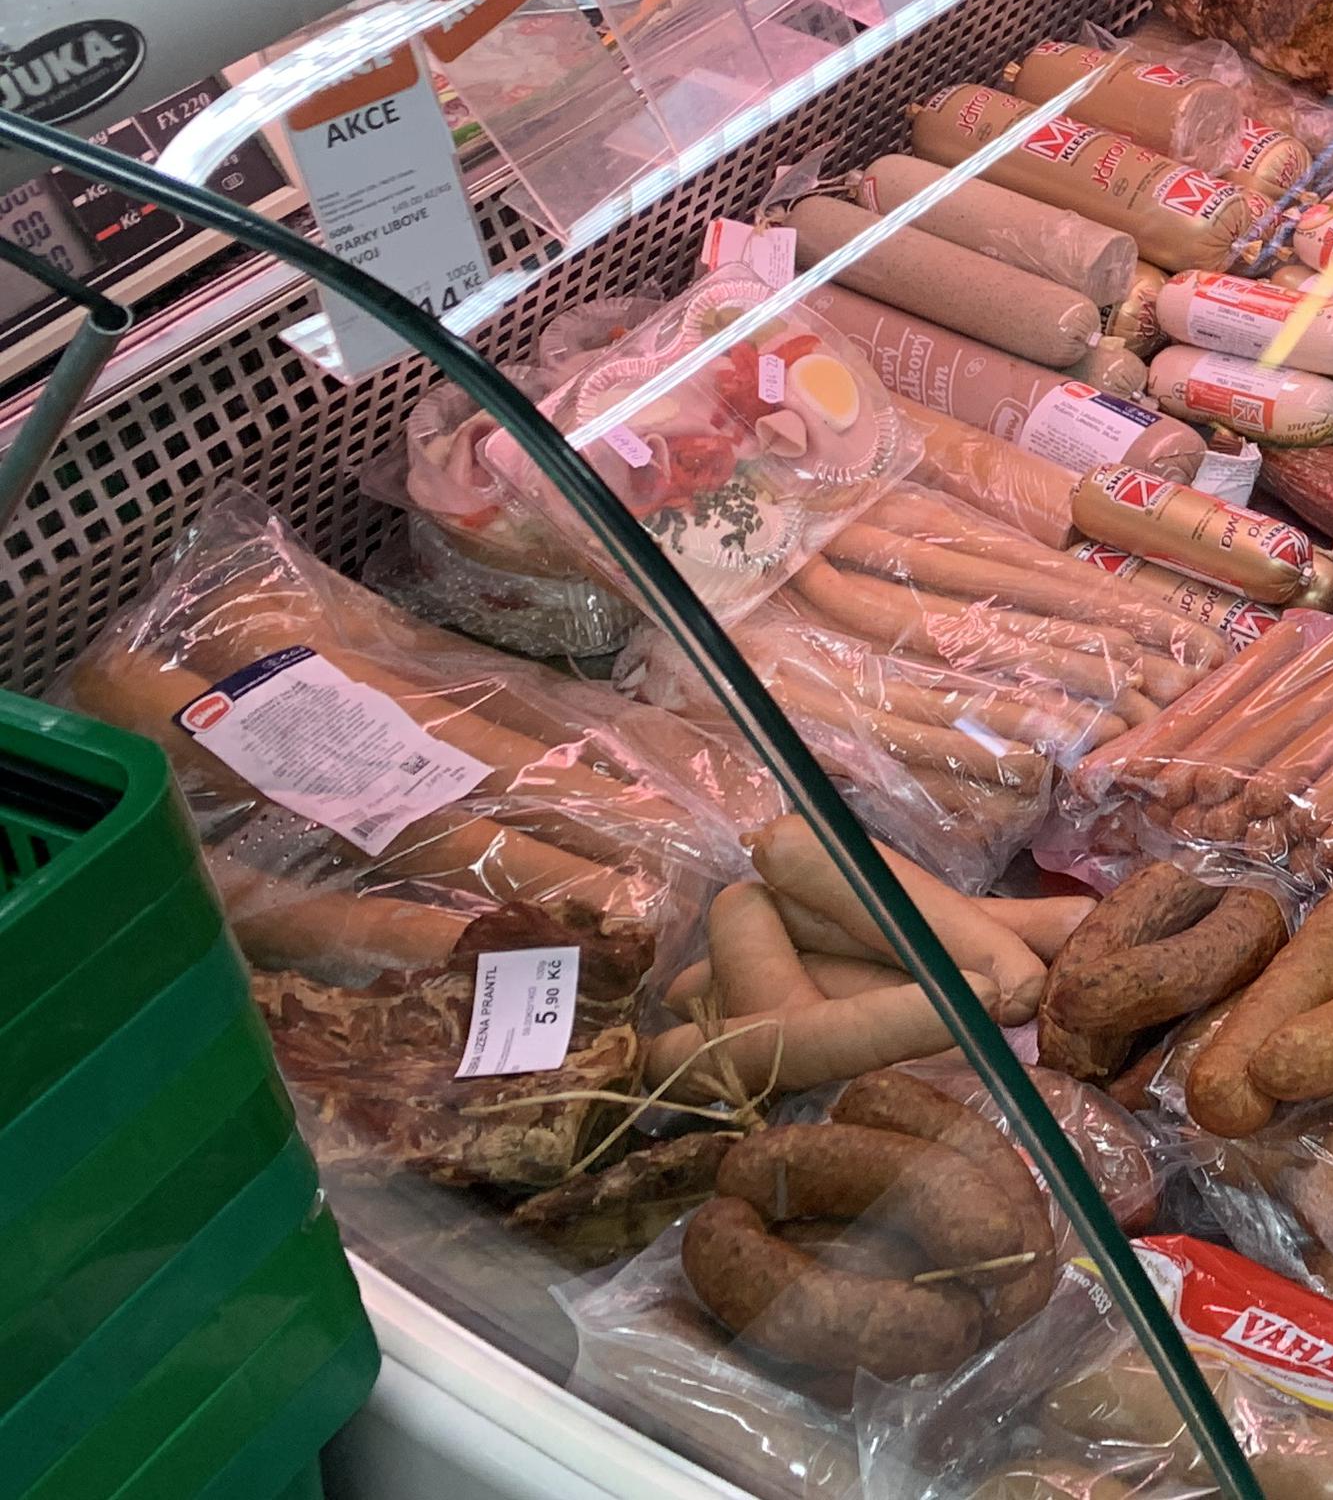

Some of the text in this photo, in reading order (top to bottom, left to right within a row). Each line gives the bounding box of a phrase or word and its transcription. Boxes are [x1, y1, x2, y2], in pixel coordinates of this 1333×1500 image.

[156, 91, 211, 131] FX 220
[326, 99, 402, 149] AKCE
[334, 206, 431, 256] PARKY LIBOVE
[349, 247, 381, 268] IVOJ
[480, 964, 498, 1016] PRANTL
[534, 958, 562, 1025] 5,90 Kč
